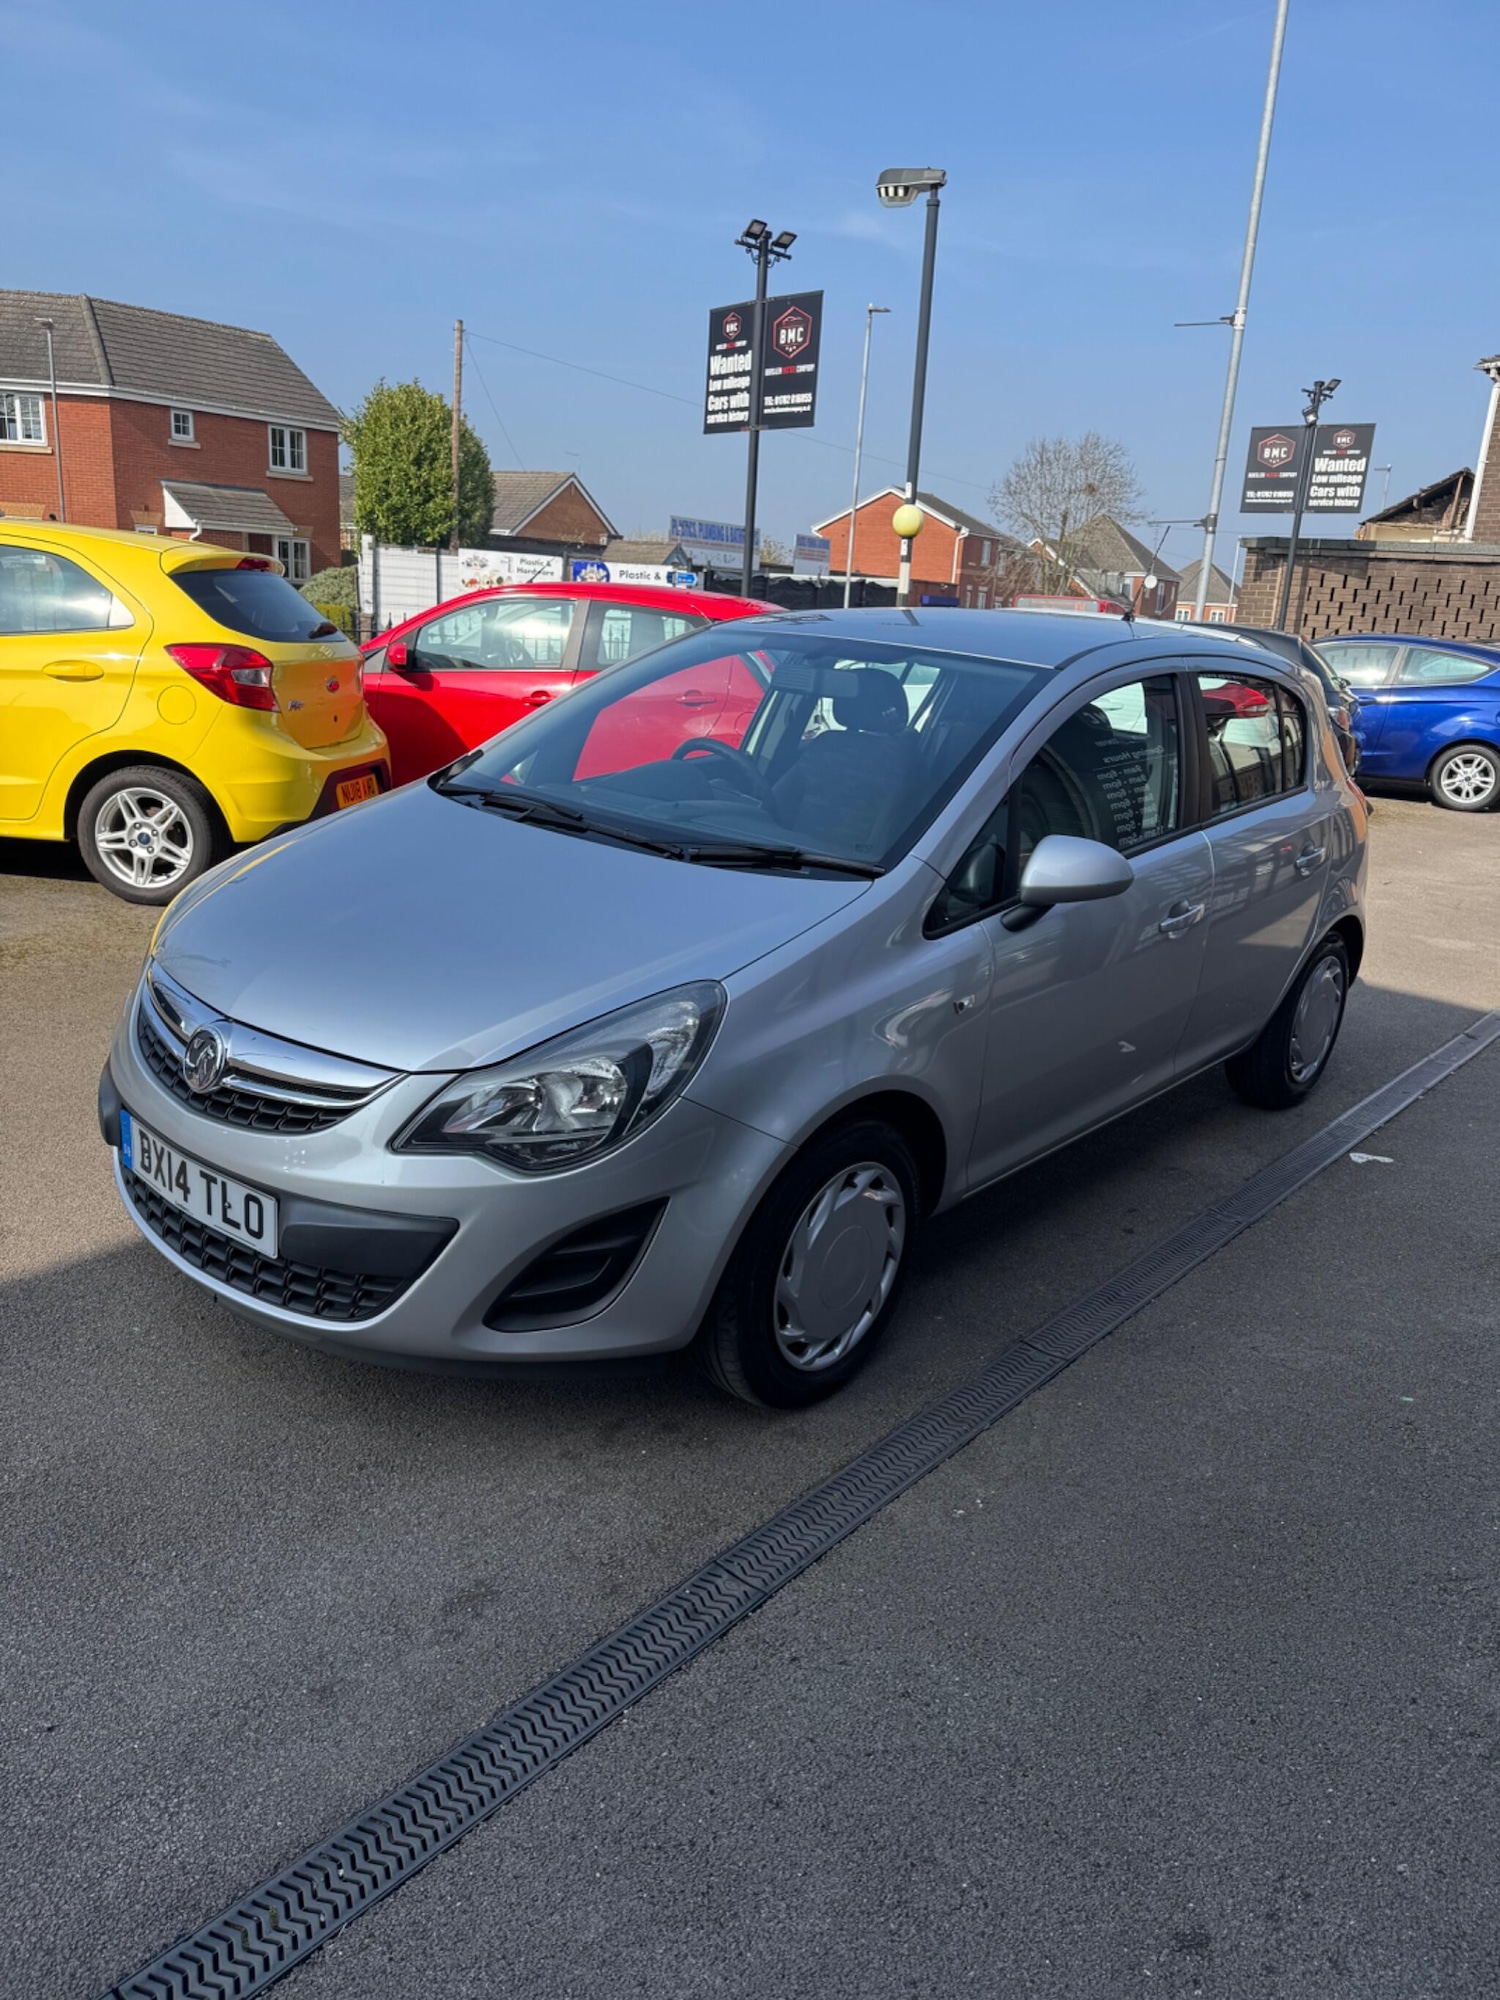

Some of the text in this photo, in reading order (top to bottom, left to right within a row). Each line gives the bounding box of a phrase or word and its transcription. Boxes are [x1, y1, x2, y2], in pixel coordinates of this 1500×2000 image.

[779, 327, 804, 344] BMC
[710, 350, 752, 376] Wanted
[709, 375, 751, 391] Low mileage
[708, 394, 728, 411] Cars
[730, 391, 750, 408] with
[1264, 448, 1288, 459] BMC
[1314, 457, 1367, 473] Wanted
[1312, 473, 1363, 485] Low mileage
[1310, 485, 1361, 498] Cars with
[519, 558, 544, 566] Plastic
[619, 569, 661, 580] Plastic &
[139, 1130, 264, 1240] BX14 TLO
